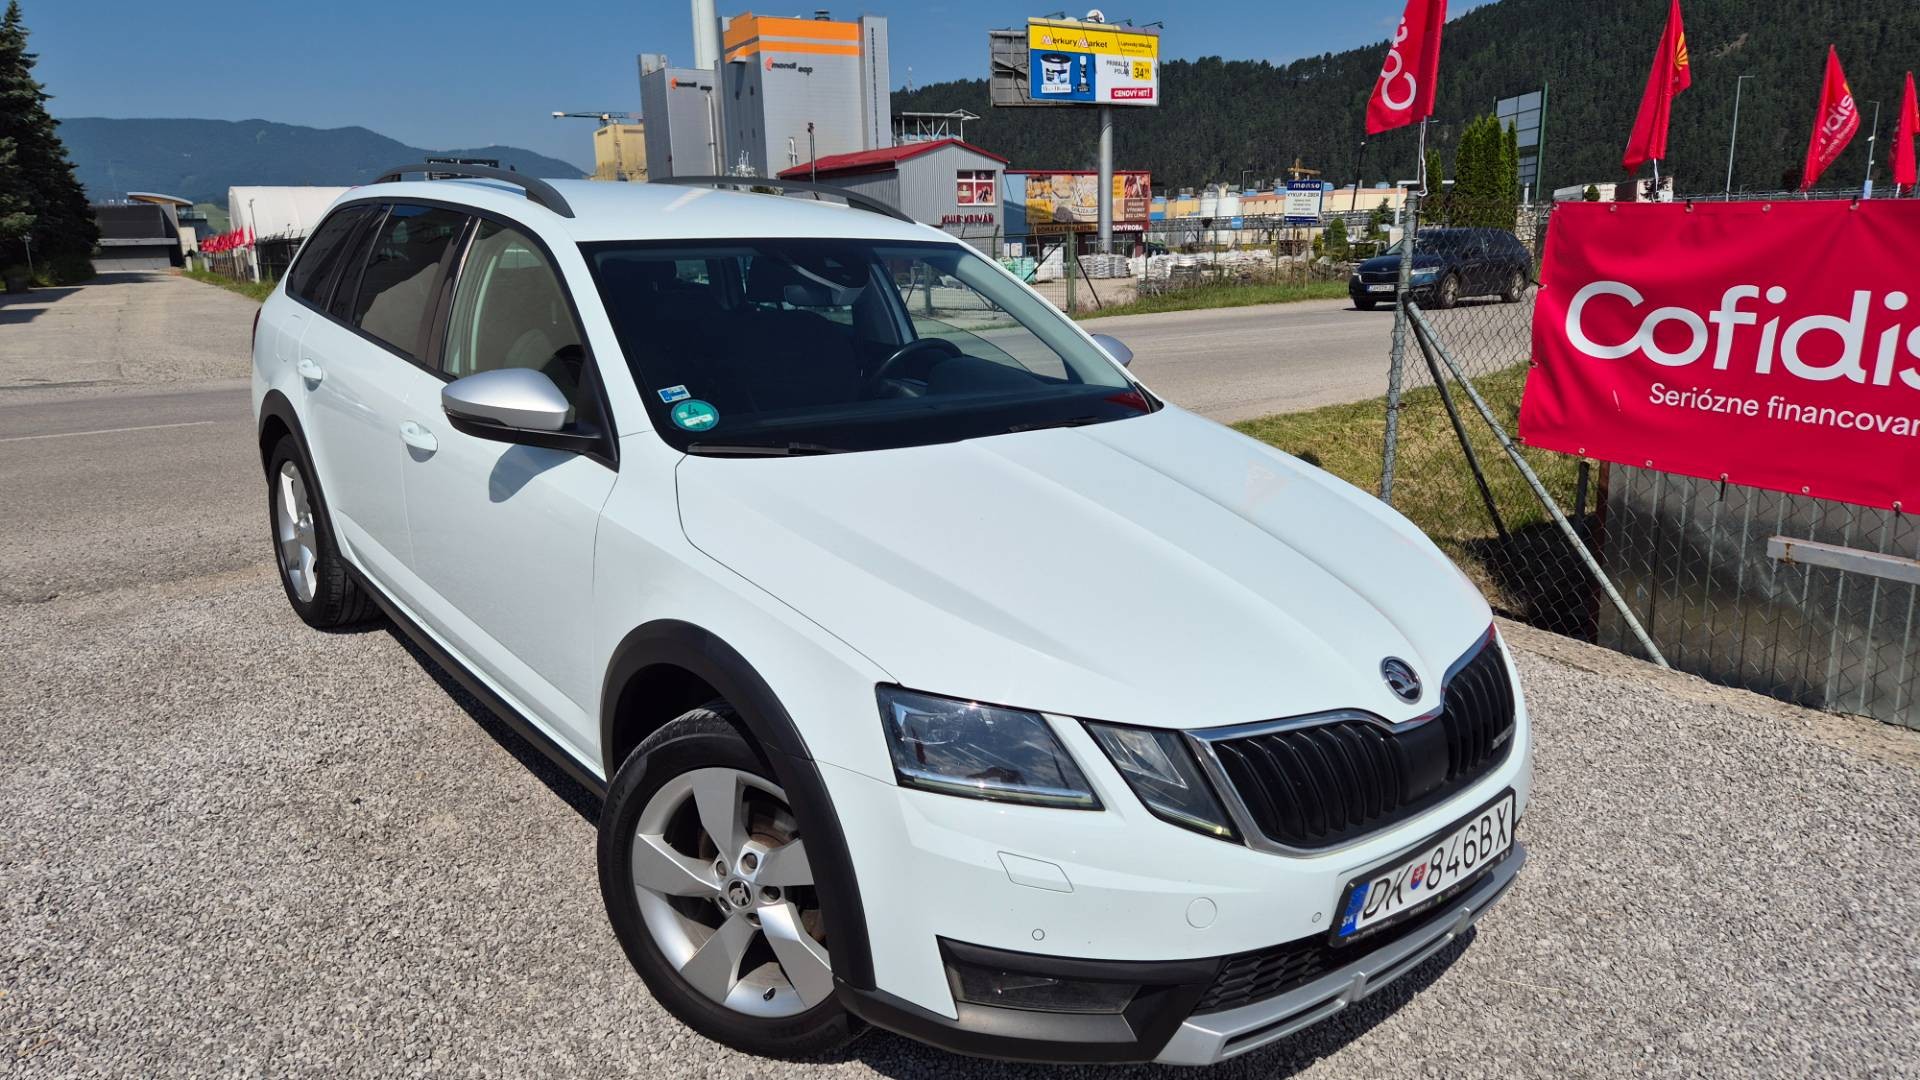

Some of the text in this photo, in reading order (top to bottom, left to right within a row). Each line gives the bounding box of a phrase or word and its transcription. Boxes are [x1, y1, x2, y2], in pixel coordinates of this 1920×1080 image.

[1649, 381, 1759, 417] Seriózne
[1362, 802, 1509, 920] DK 846BX
